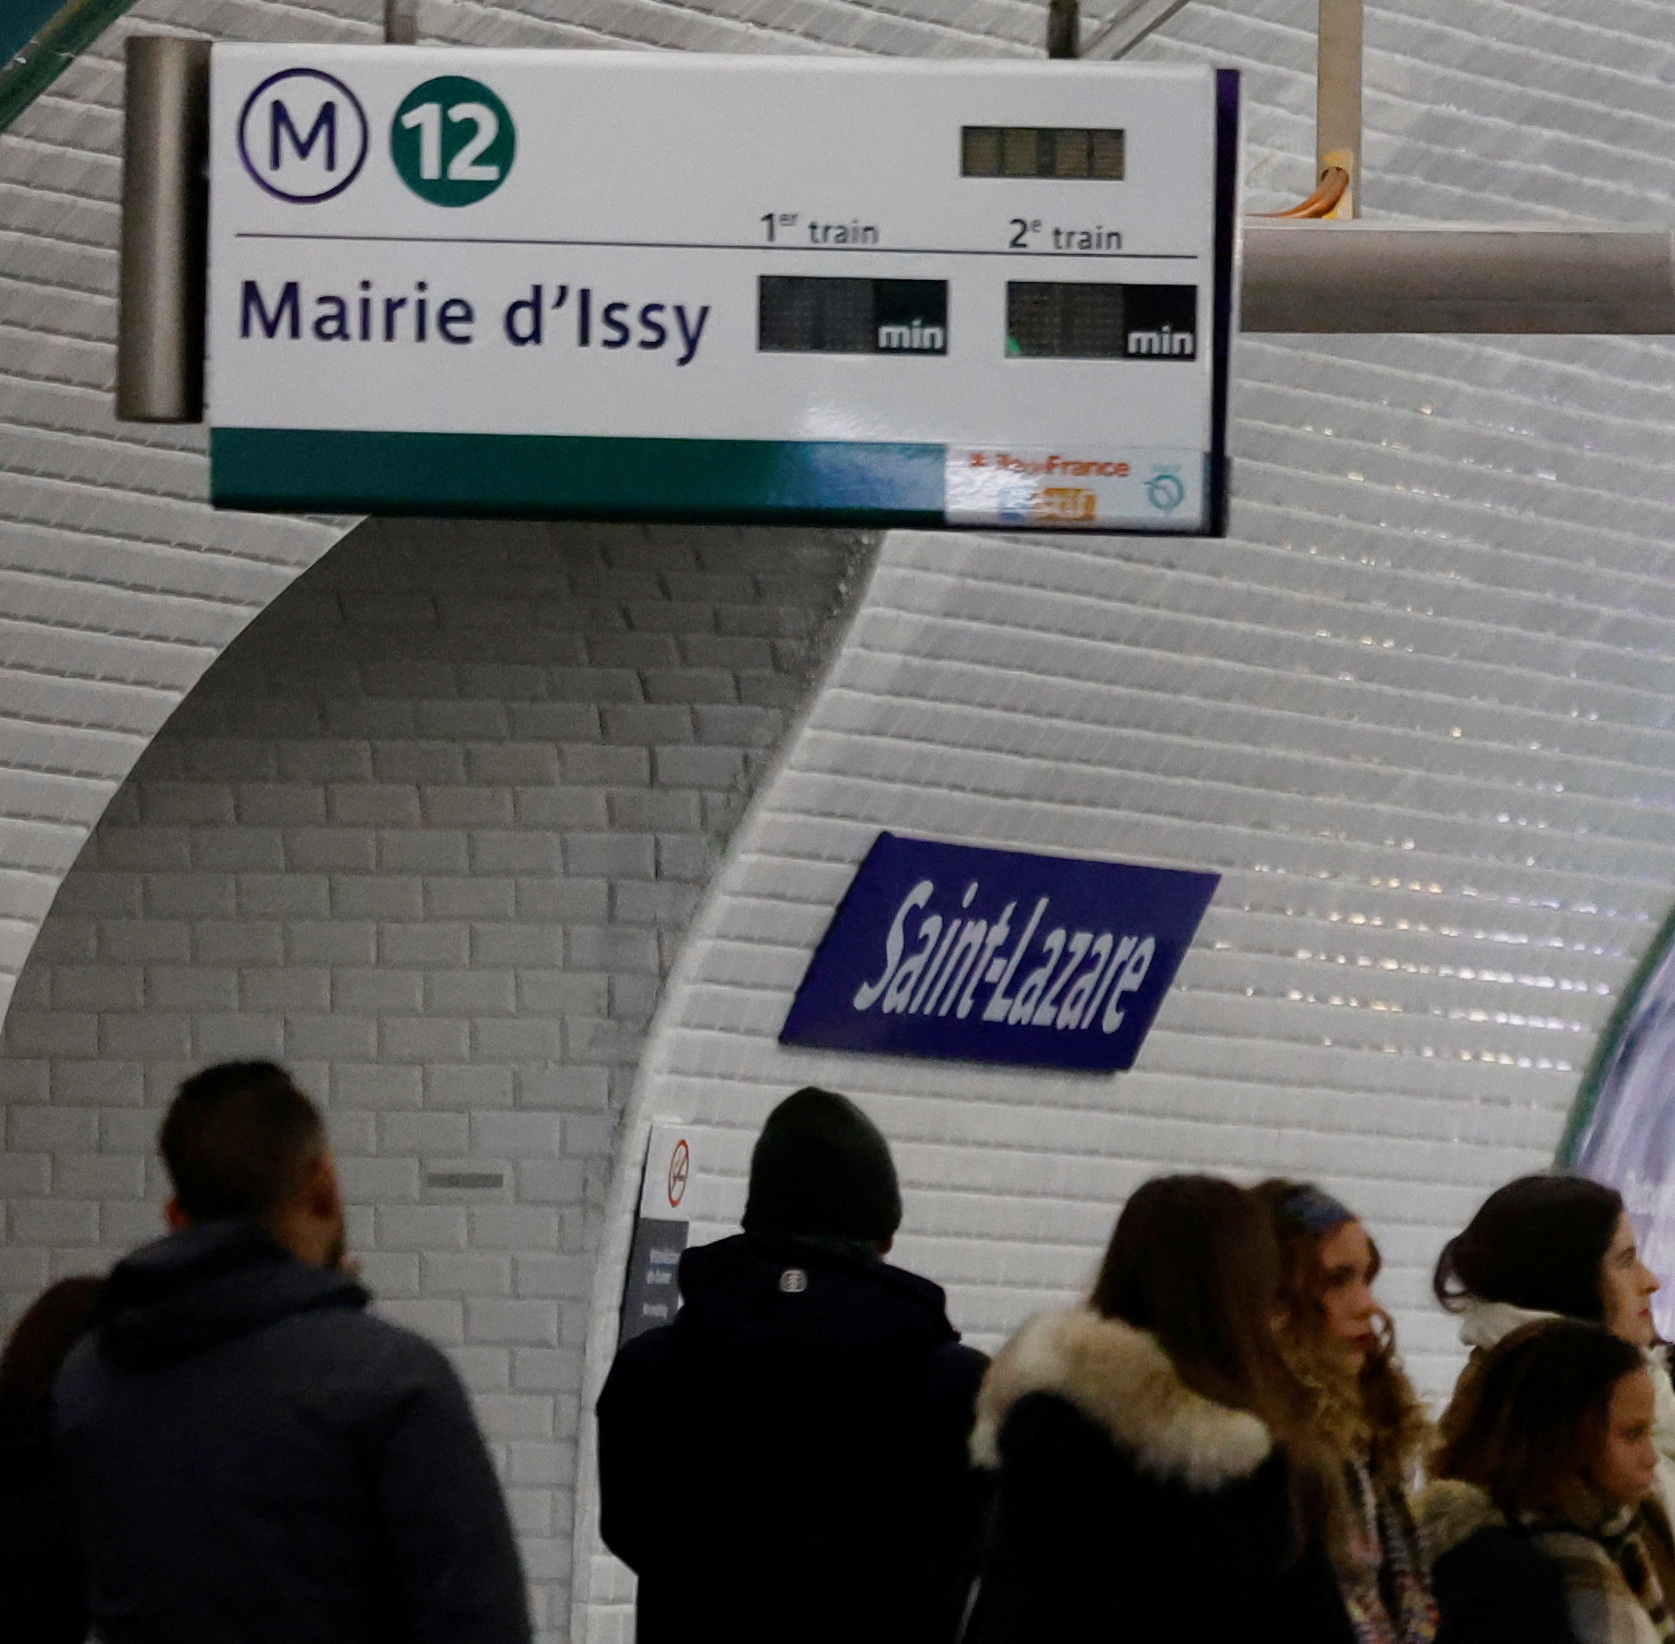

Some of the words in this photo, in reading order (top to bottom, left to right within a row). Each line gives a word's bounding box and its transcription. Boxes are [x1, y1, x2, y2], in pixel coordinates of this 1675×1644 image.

[268, 98, 338, 172] M
[400, 101, 501, 182] 12
[807, 213, 881, 246] train
[1052, 224, 1124, 252] train
[239, 279, 476, 345] Mairie
[877, 317, 946, 352] min
[1126, 324, 1195, 357] min
[852, 878, 1157, 1036] Saint-Lazare
